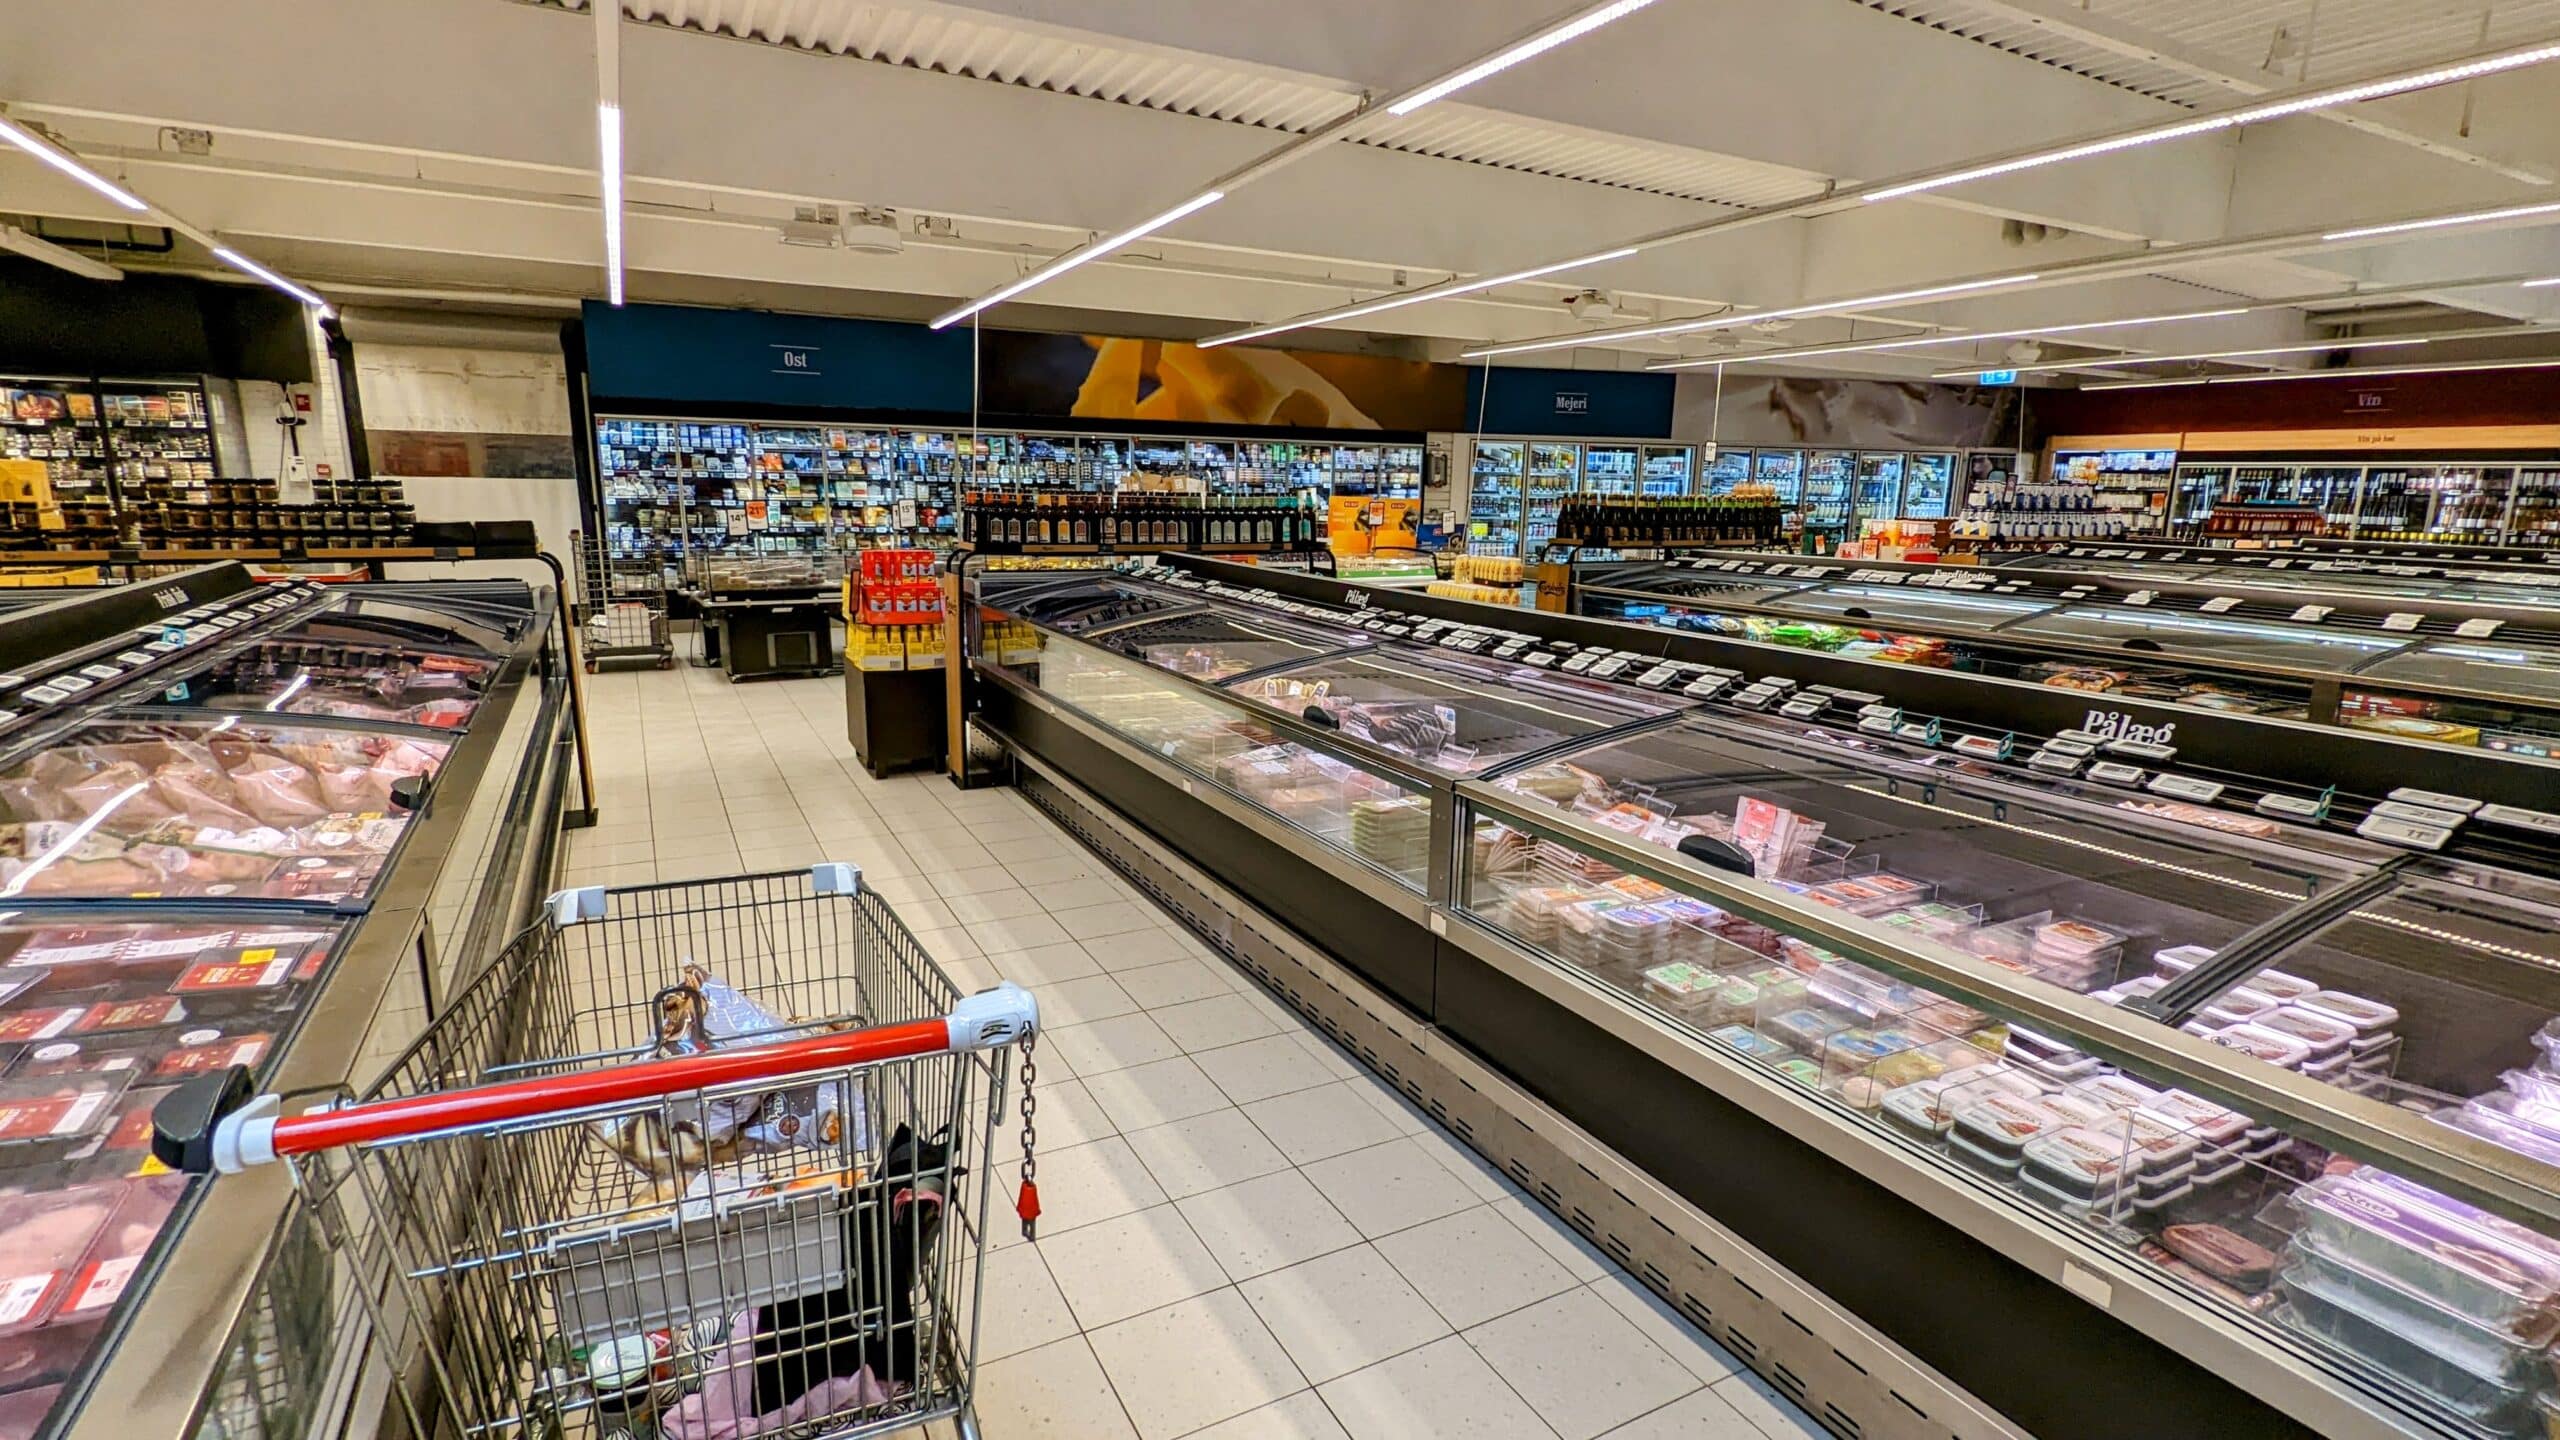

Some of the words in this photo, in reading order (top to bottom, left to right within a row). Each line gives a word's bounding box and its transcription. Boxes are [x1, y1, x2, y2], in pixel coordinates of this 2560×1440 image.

[784, 351, 808, 368] Ost
[1556, 396, 1588, 411] Mejeri
[2358, 393, 2382, 407] Vin
[2083, 710, 2177, 745] Pålæg
